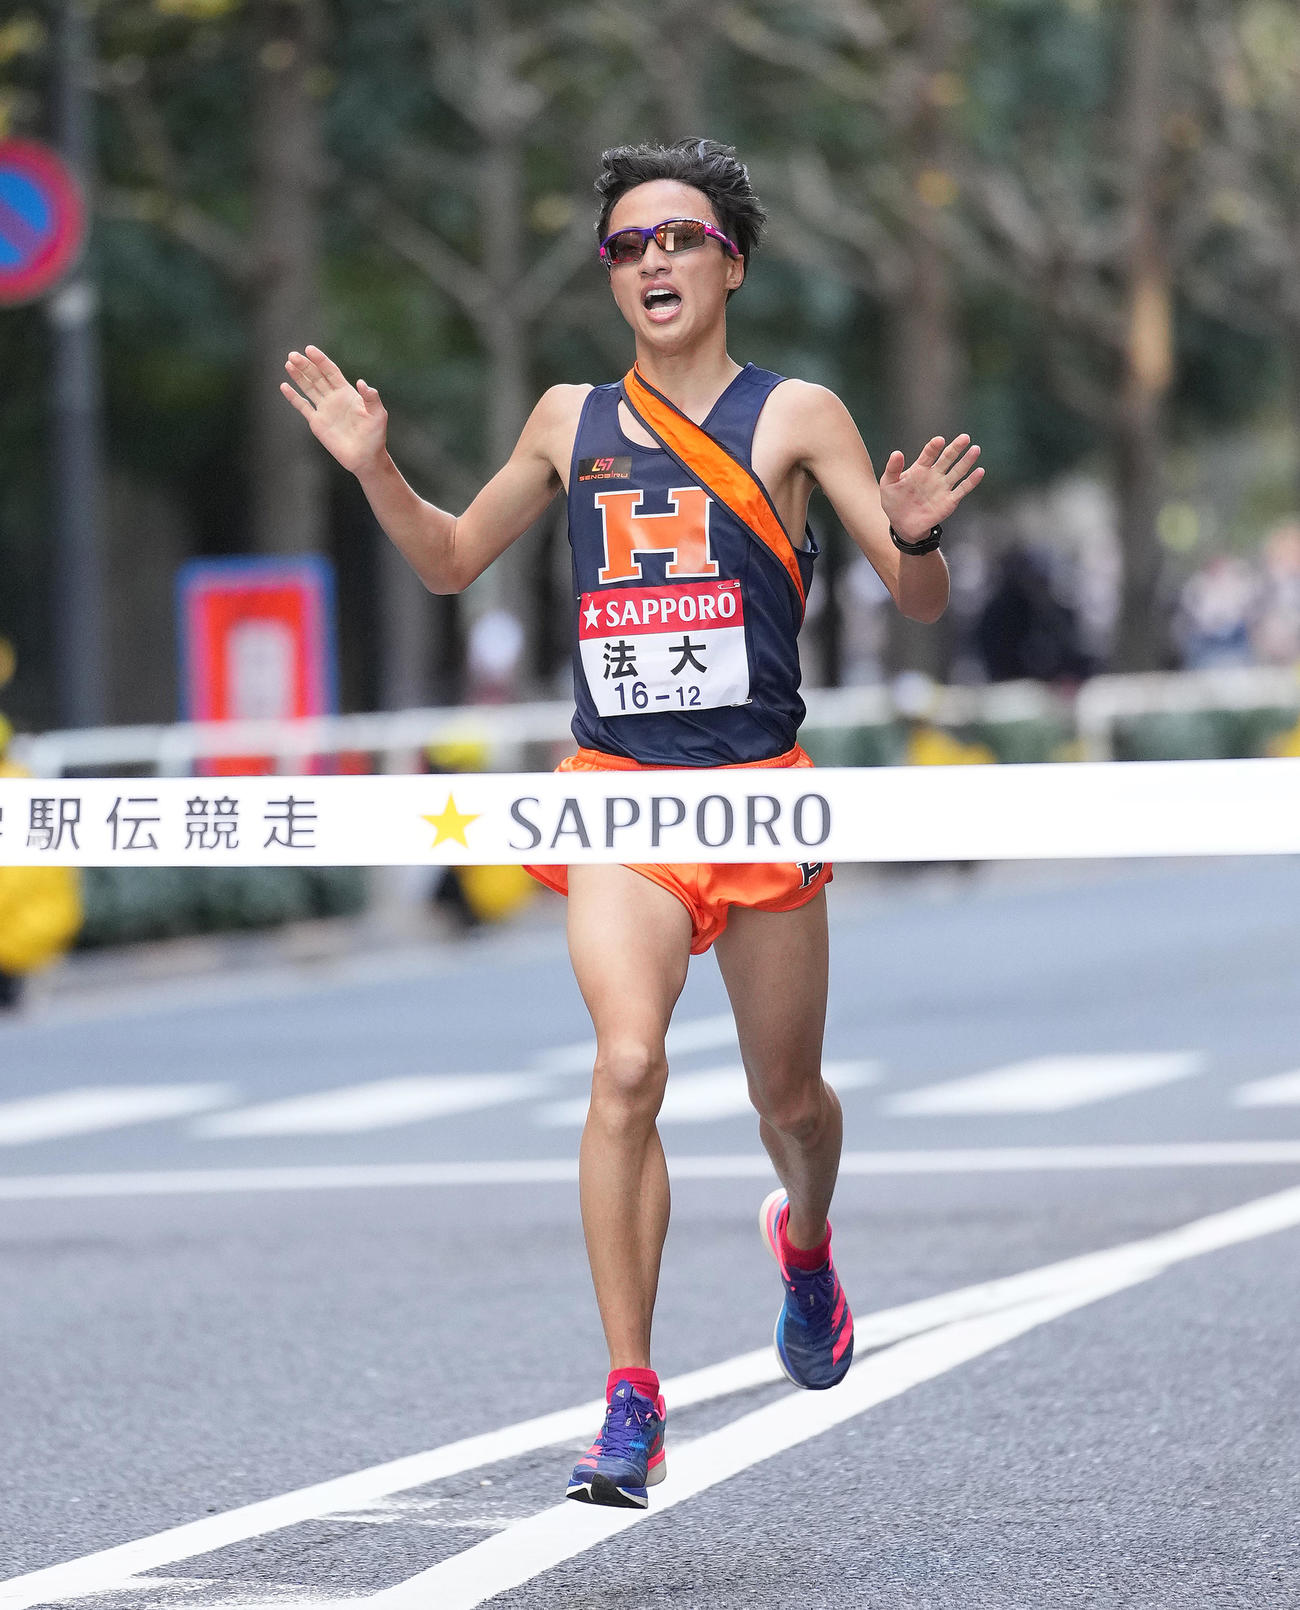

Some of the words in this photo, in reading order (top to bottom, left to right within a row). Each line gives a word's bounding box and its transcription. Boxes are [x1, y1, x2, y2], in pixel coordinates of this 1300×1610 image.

[594, 486, 720, 585] H
[605, 592, 737, 628] SAPPORO
[0, 795, 318, 851] 駅伝競走
[509, 793, 832, 851] SAPPORO
